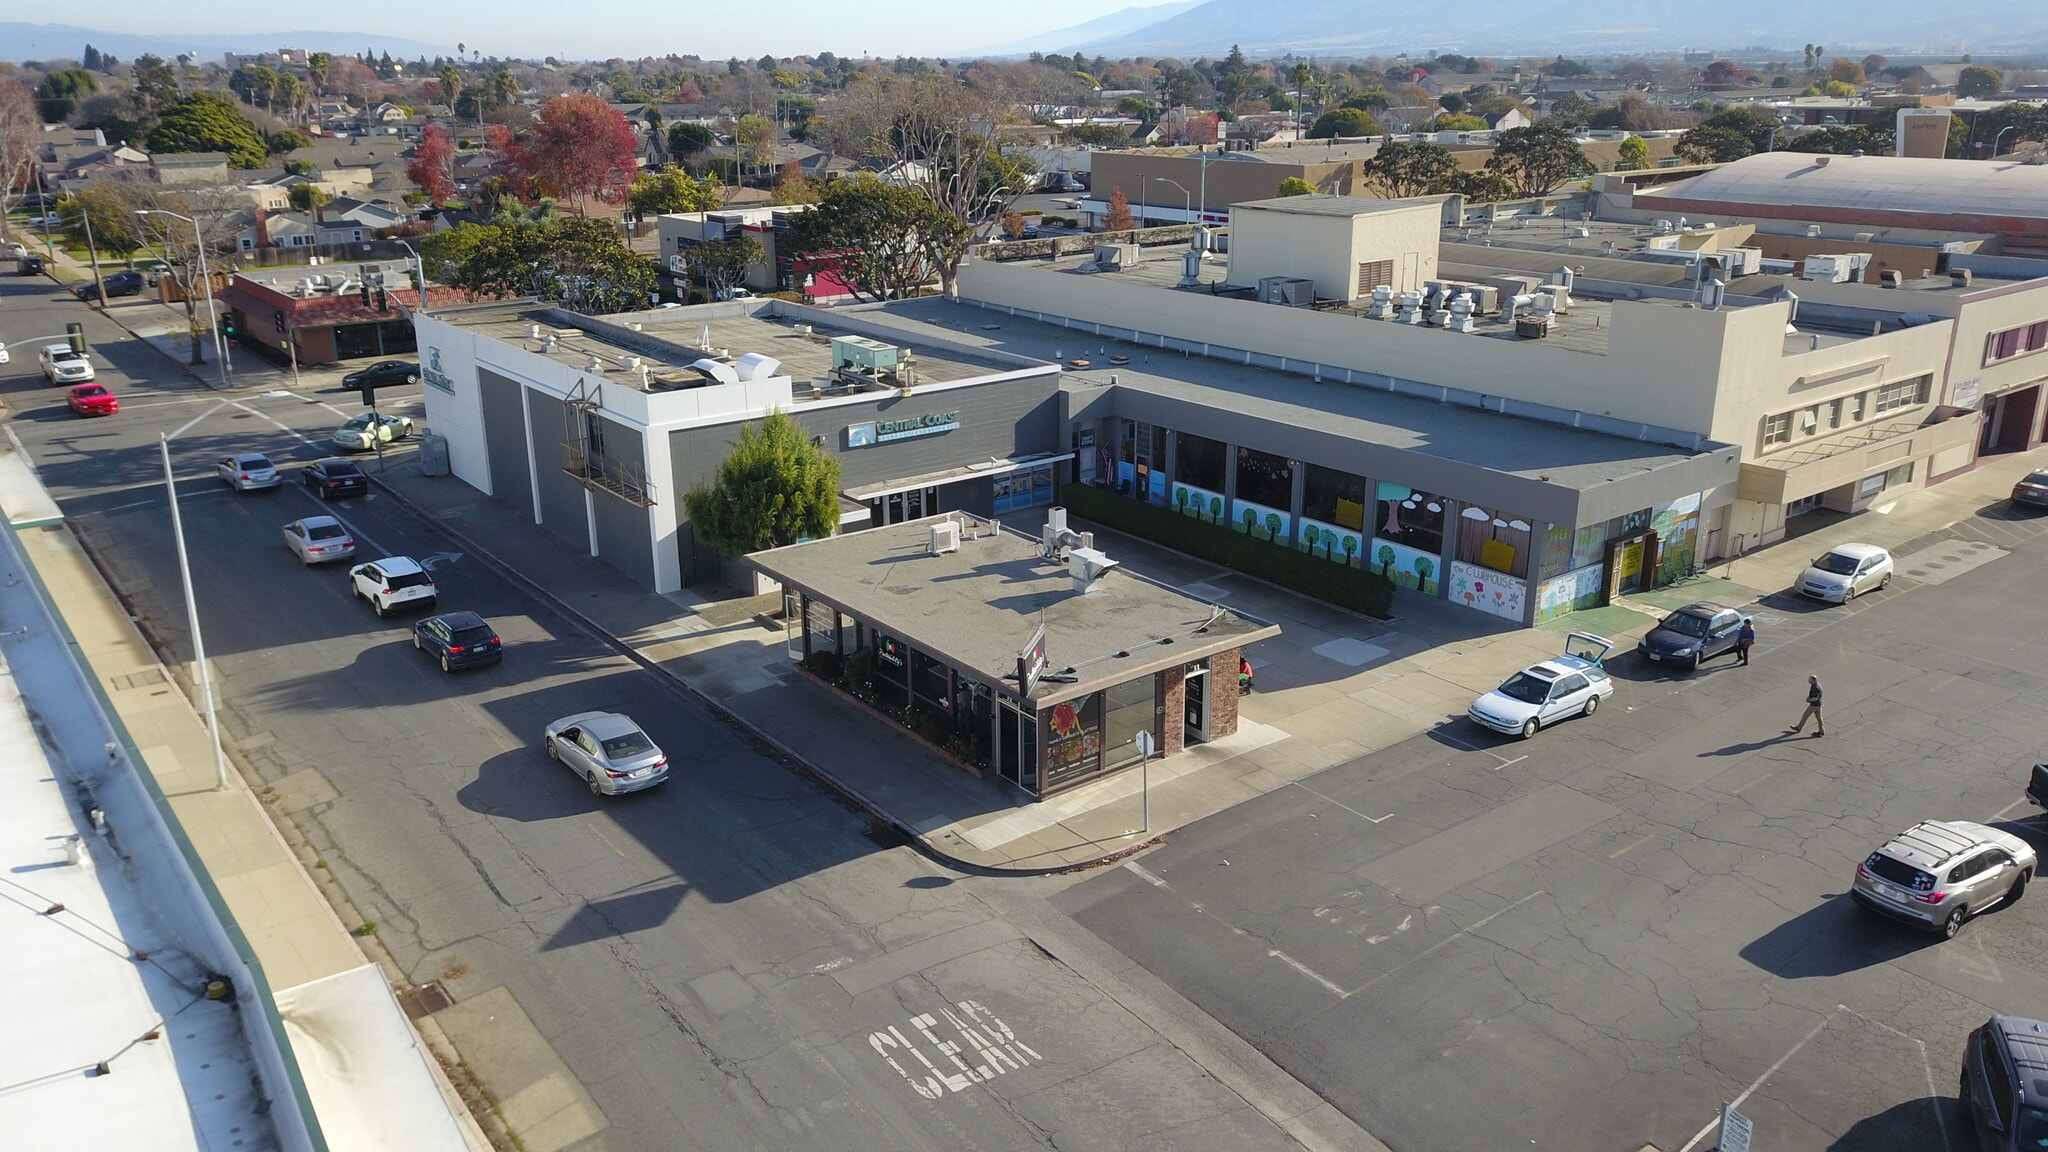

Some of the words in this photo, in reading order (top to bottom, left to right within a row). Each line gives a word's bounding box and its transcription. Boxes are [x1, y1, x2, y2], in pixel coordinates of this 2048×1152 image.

[877, 417, 923, 434] CENTRAL
[925, 410, 960, 426] COAST
[869, 1000, 1043, 1099] CLEAR
